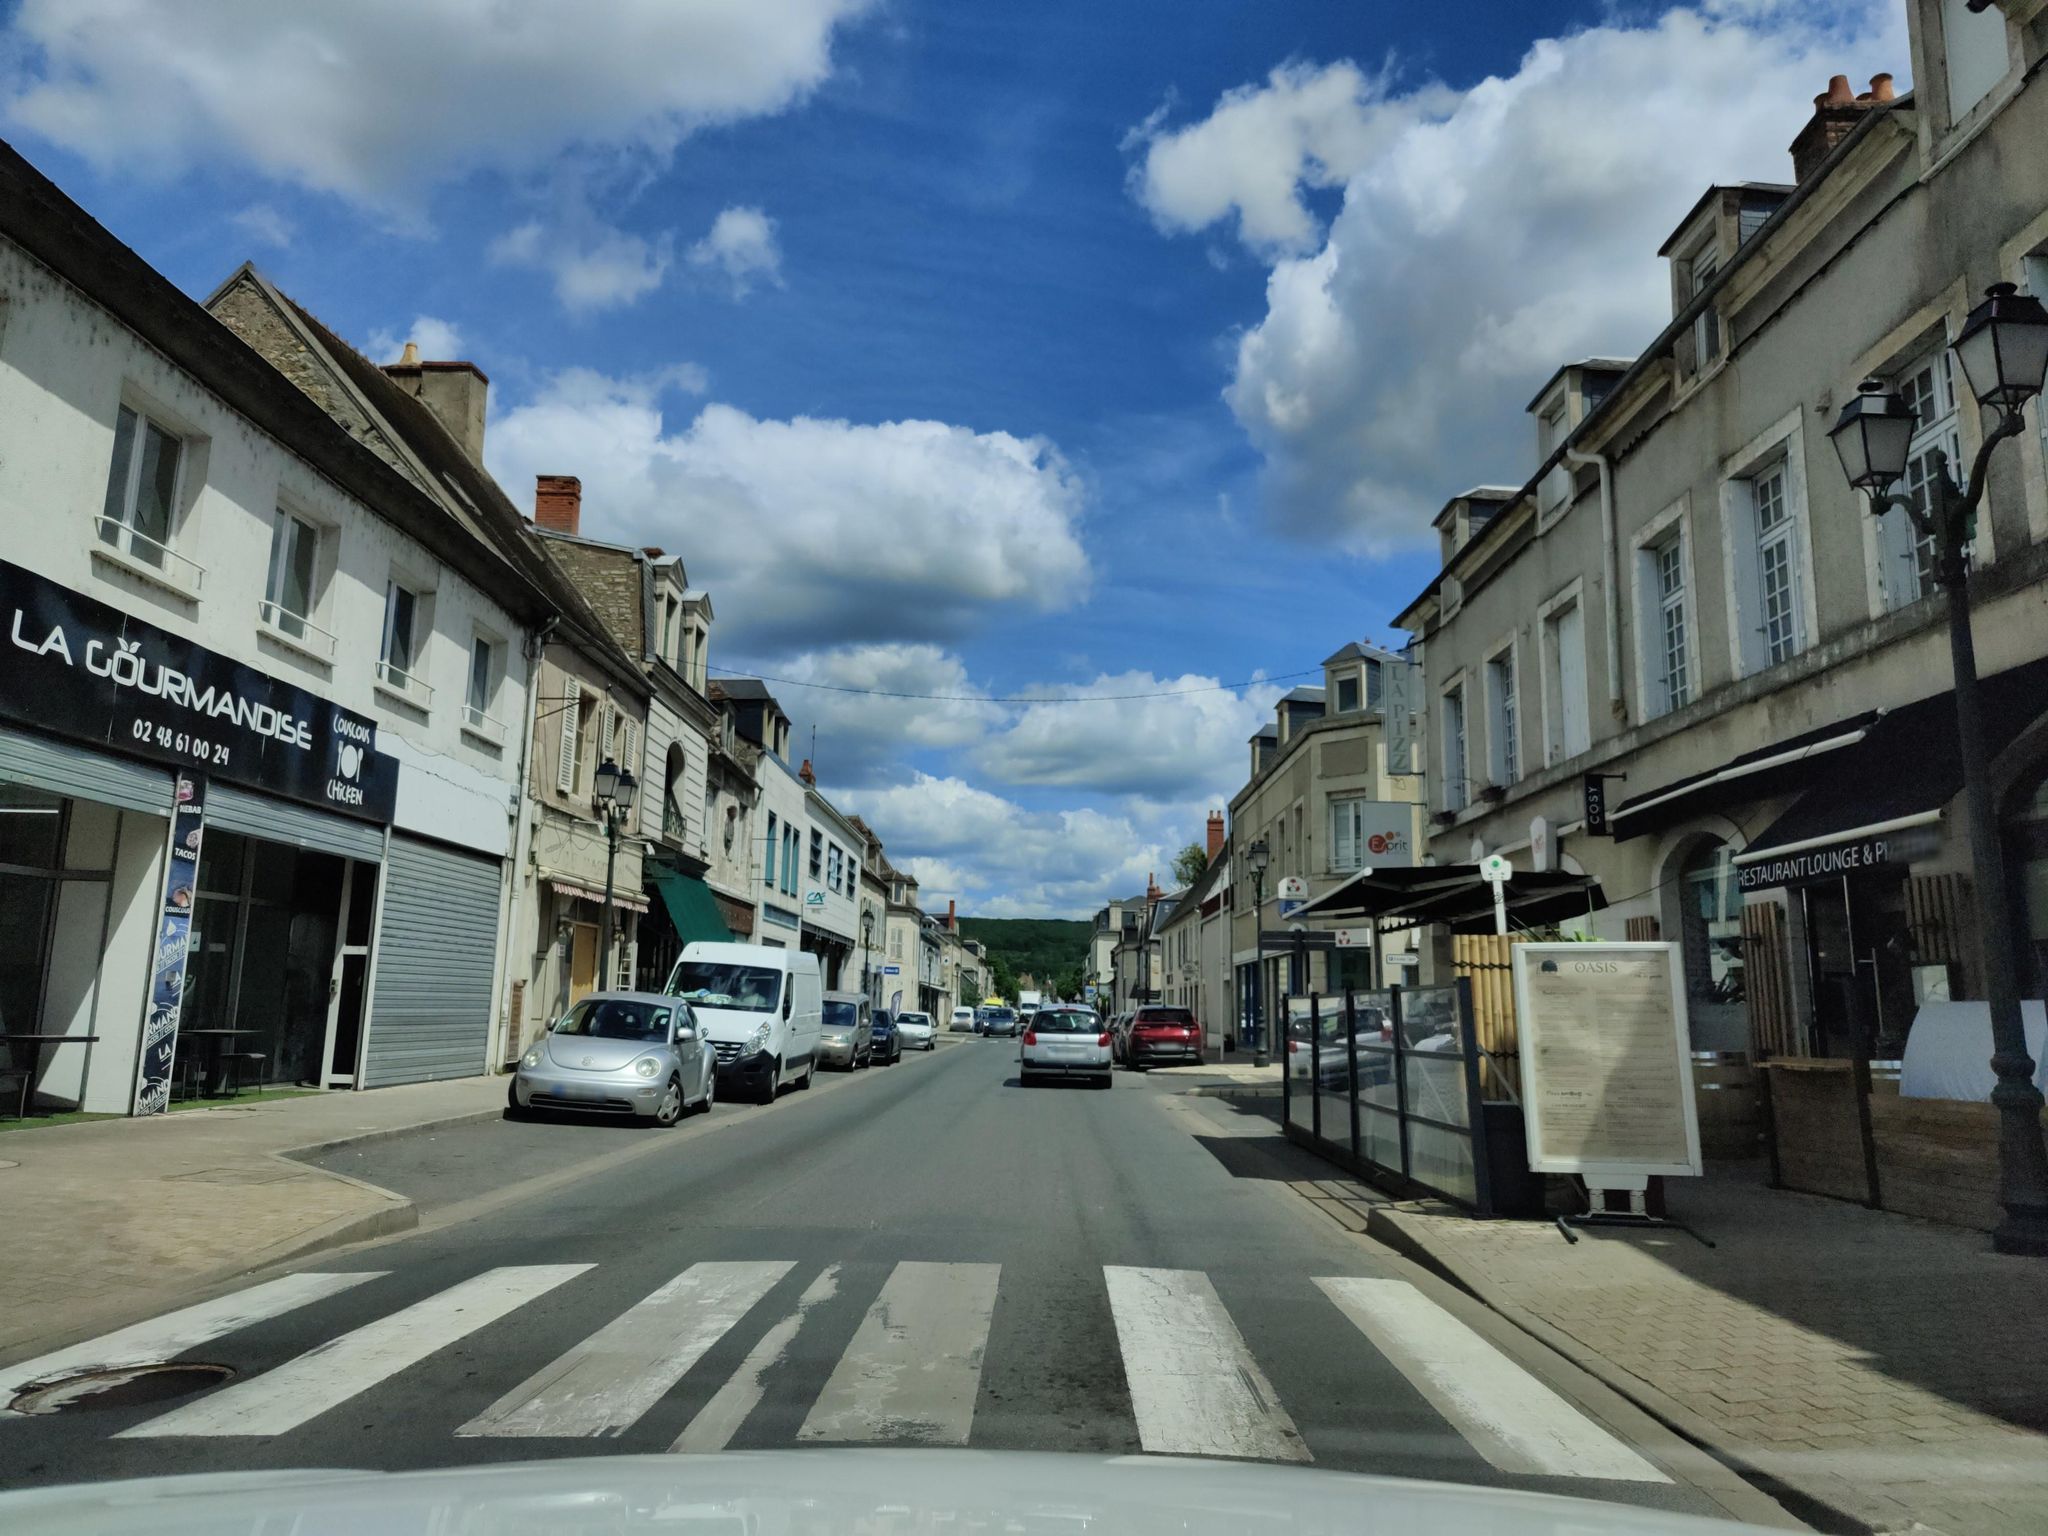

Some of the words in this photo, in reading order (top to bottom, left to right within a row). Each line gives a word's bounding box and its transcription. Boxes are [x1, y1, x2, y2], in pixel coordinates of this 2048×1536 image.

[11, 608, 73, 666] LA
[85, 640, 312, 750] GOURMANDISE
[133, 719, 152, 743] 02
[156, 725, 173, 750] 48
[176, 733, 190, 755] 61
[192, 739, 209, 760] 00
[213, 744, 229, 766] 24
[333, 713, 370, 743] COUSCOUS
[1589, 786, 1600, 824] COSY
[175, 847, 196, 860] TACOS
[1738, 857, 1806, 886] RESTAURANT
[1807, 846, 1859, 875] LOUNGE
[1863, 844, 1873, 865] &
[1574, 962, 1618, 974] OASIS
[158, 1043, 171, 1060] LA
